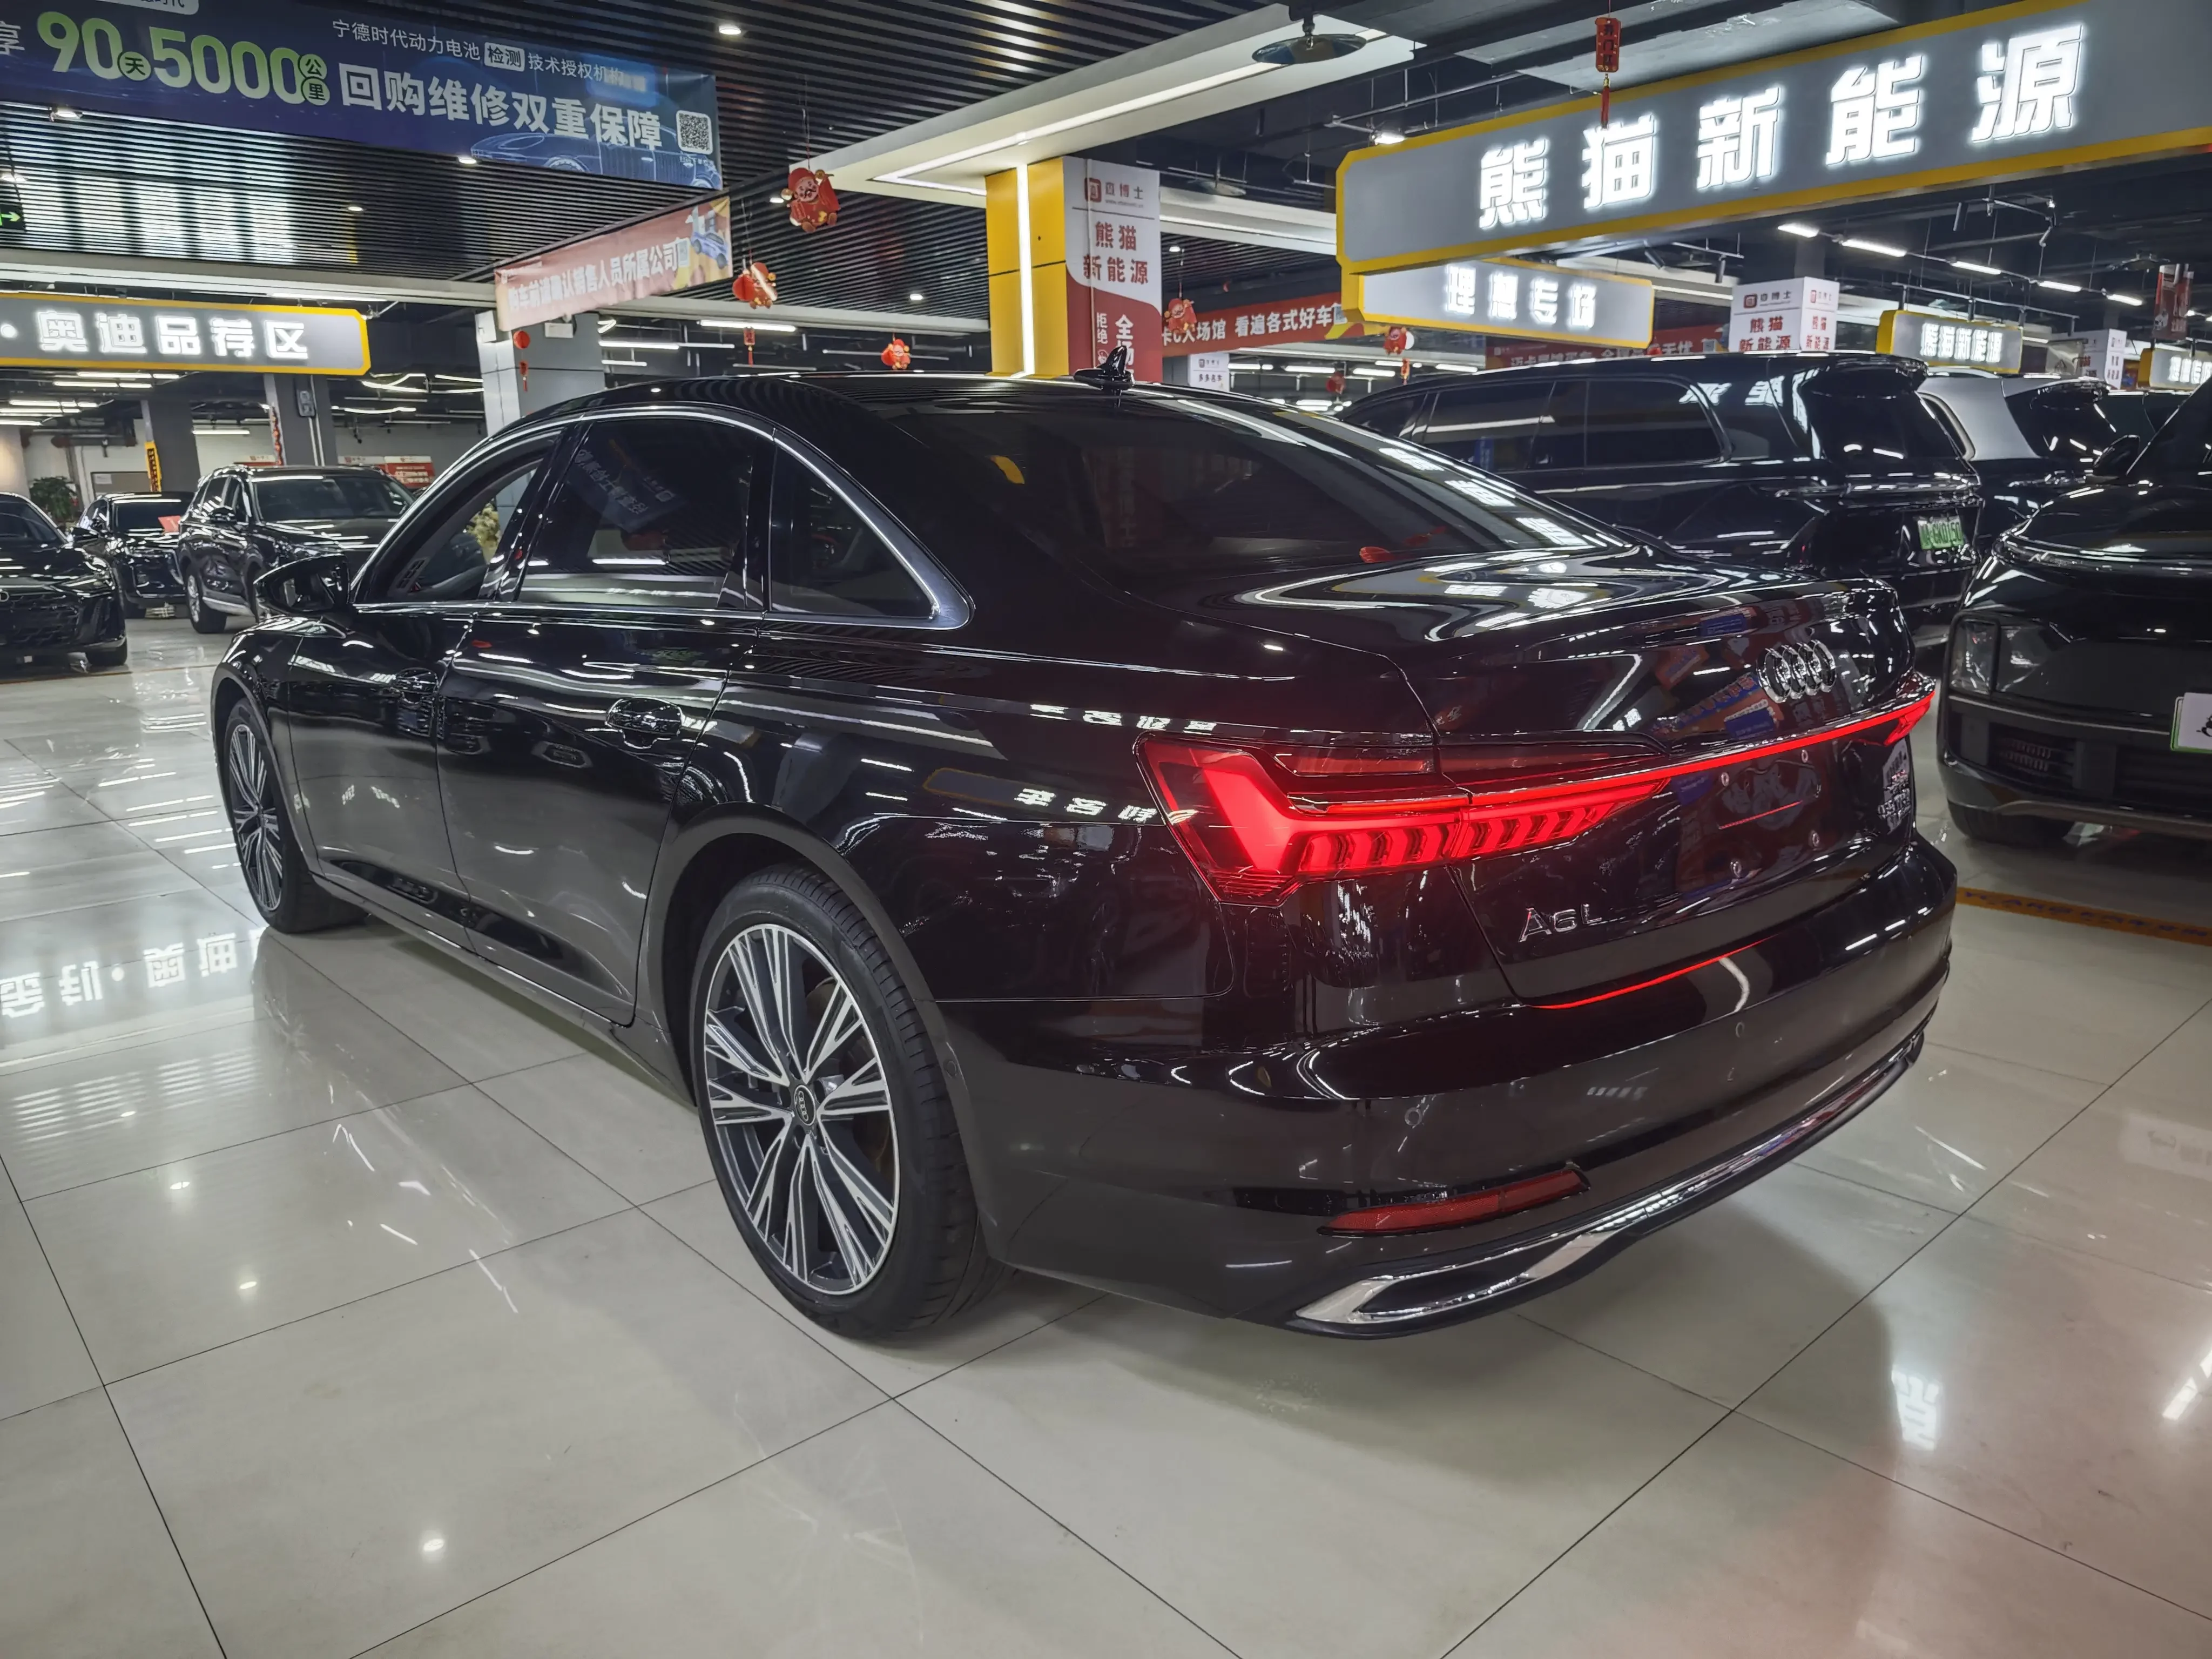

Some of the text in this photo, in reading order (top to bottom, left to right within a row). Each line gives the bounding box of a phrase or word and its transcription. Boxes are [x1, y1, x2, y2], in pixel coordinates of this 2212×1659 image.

[332, 19, 481, 61] 宁德时代动力电池
[487, 45, 522, 68] 检测
[339, 63, 662, 151] 回购维修双重保障
[1479, 24, 2086, 230] 熊猫新能源
[1095, 221, 1137, 251] 熊猫
[1083, 253, 1149, 285] 新能源
[1235, 305, 1333, 338] 看遍各式好车
